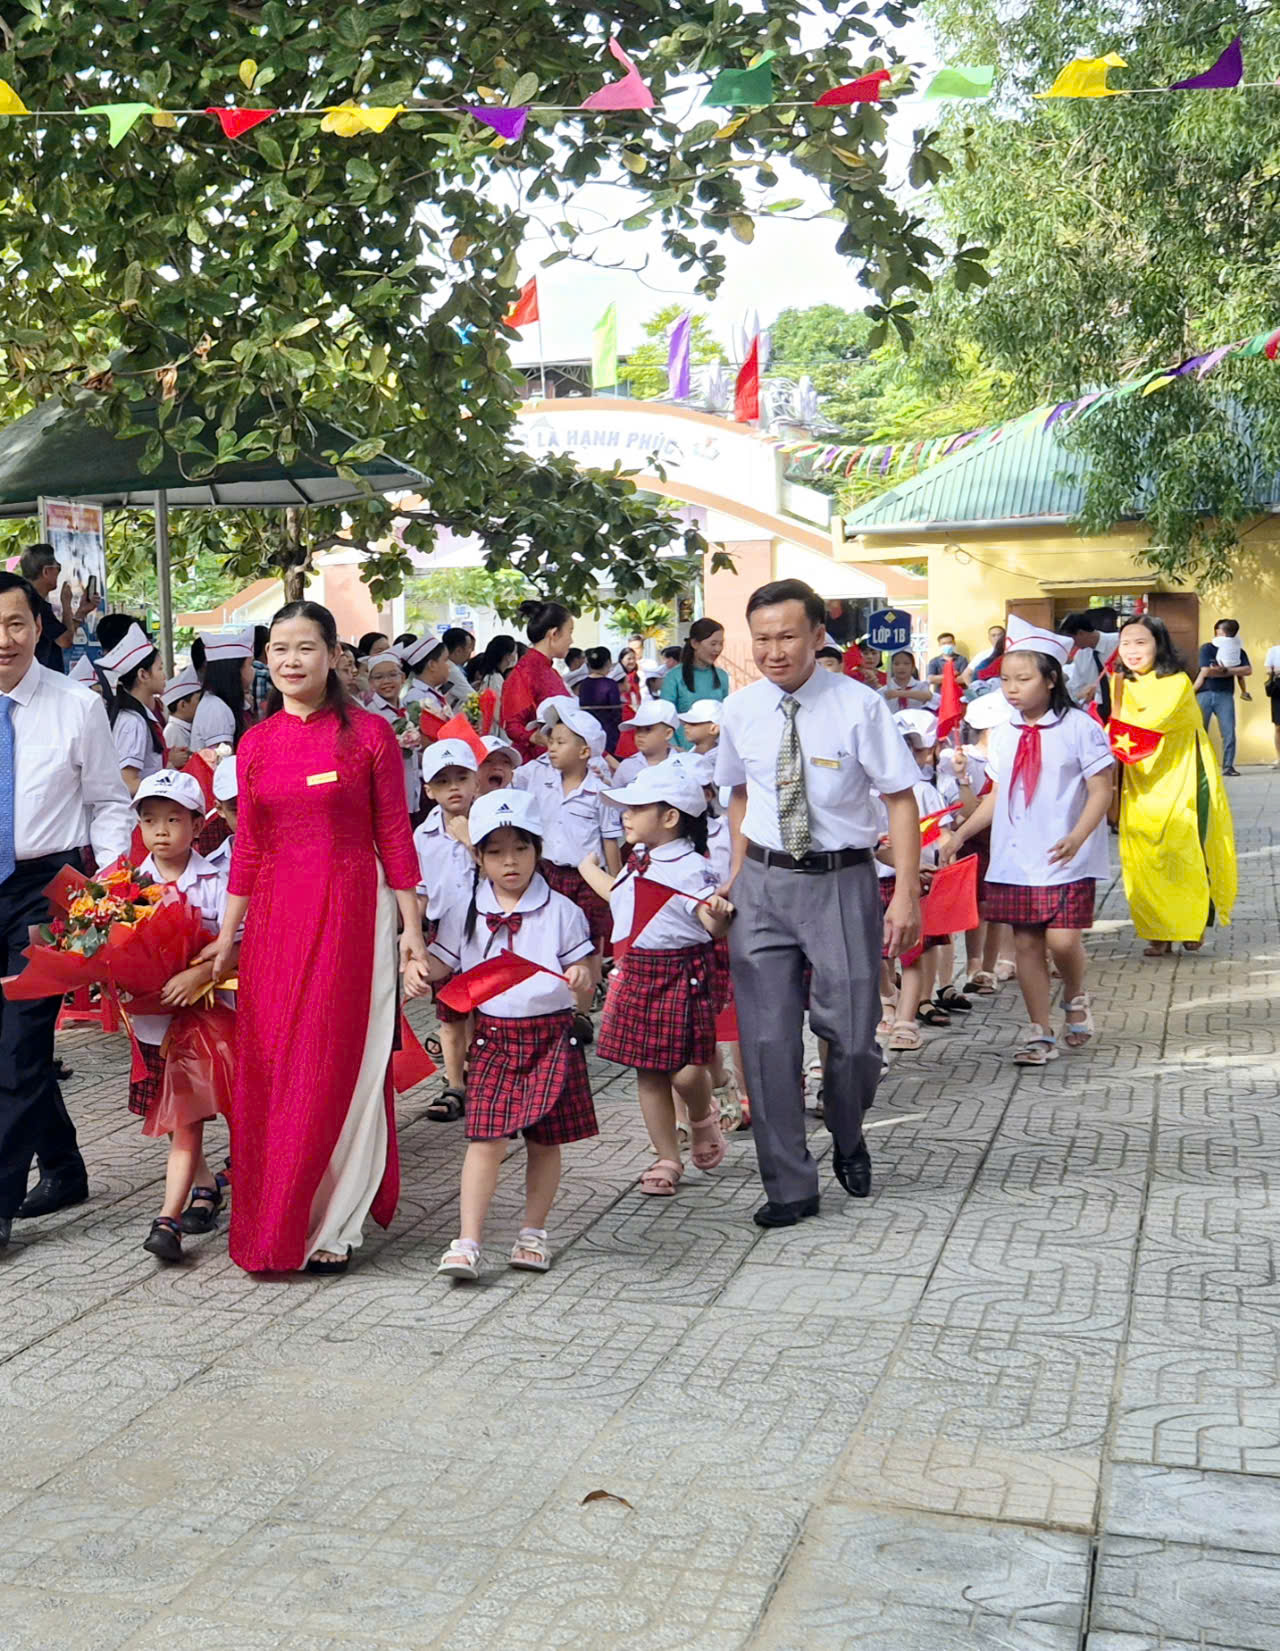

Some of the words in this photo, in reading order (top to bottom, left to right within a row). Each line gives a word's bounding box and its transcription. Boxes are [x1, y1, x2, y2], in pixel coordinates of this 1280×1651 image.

[567, 430, 620, 450] HẠNH
[872, 625, 891, 644] LỚP
[893, 628, 906, 643] 1B
